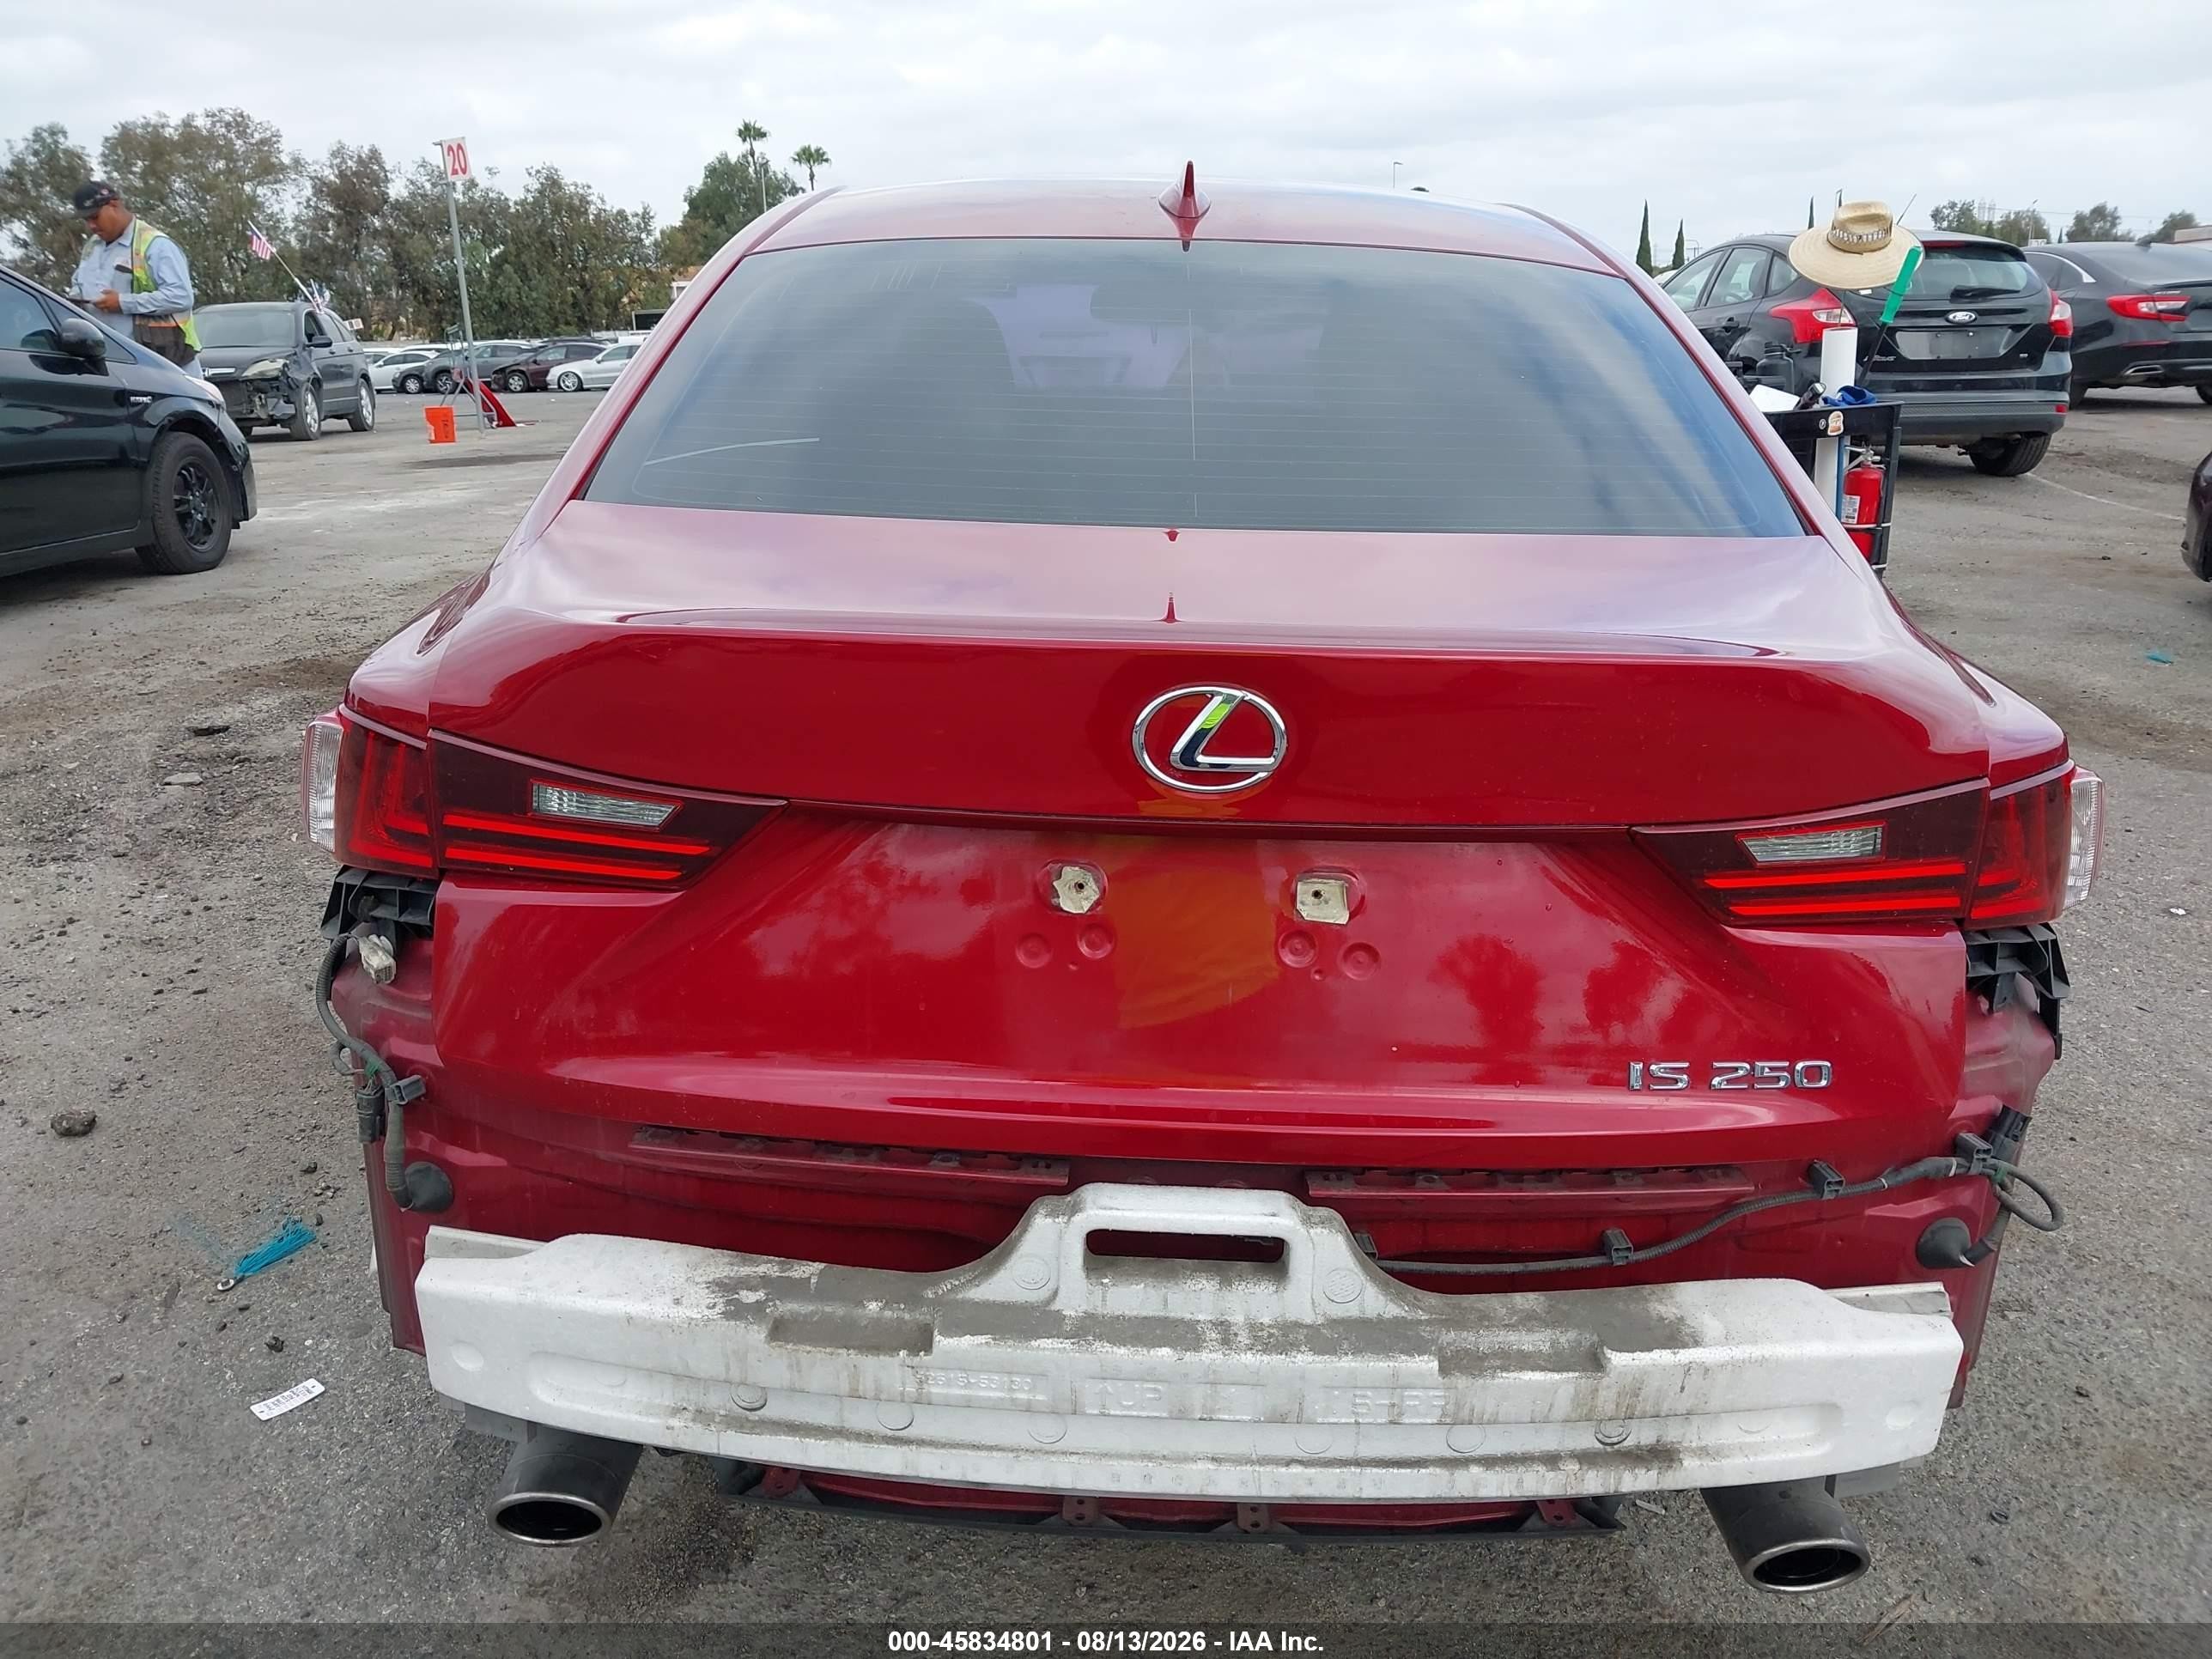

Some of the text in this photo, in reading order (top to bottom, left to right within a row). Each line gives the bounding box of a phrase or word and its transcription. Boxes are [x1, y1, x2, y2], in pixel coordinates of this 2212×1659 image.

[447, 143, 468, 176] 20
[1629, 1060, 1832, 1091] IS 250
